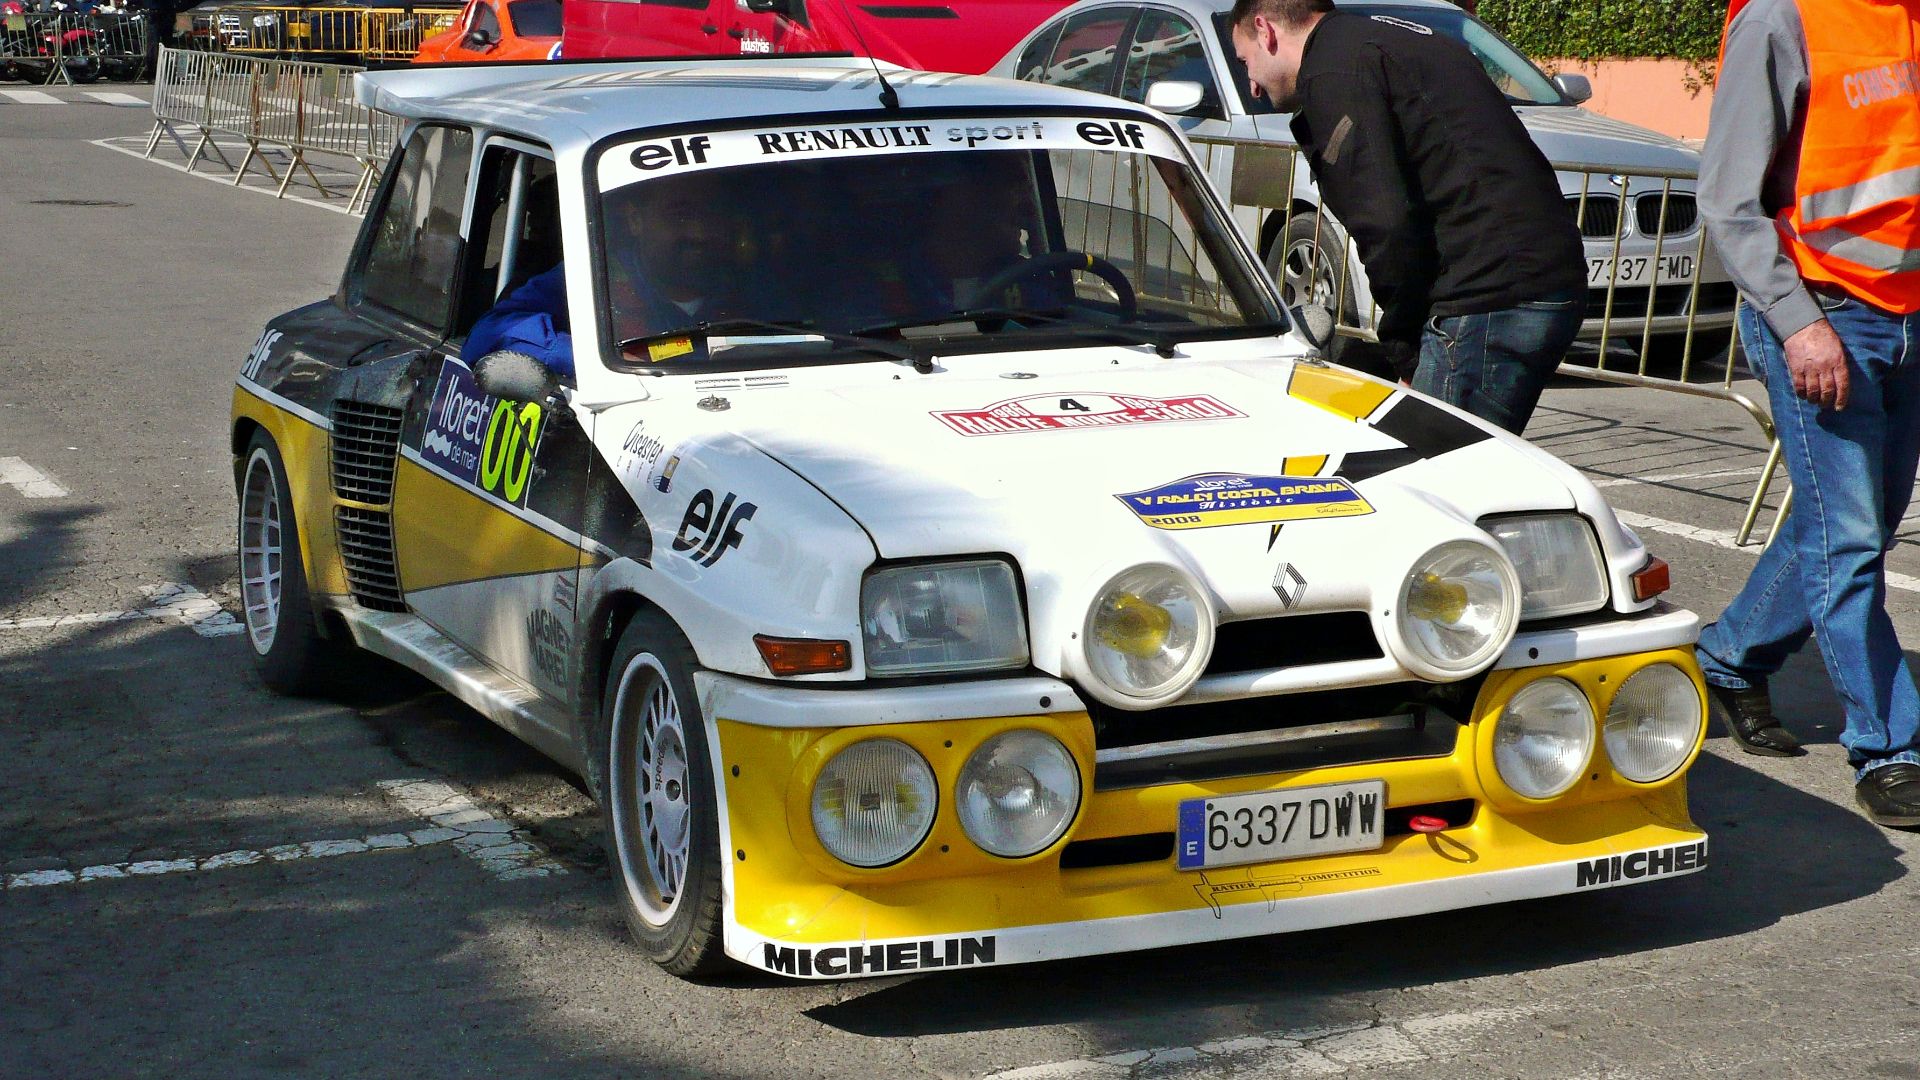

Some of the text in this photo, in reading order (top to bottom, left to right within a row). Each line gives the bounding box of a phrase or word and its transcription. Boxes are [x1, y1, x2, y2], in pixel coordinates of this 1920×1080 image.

[754, 122, 1044, 155] RENAULT sport
[1076, 121, 1145, 149] elf
[630, 136, 711, 170] elf
[1591, 255, 1693, 282] 7337 FMD
[438, 373, 490, 446] lloret
[947, 399, 1229, 434] RALLYE MONTE-CARLO
[987, 401, 1032, 418] 1986
[1059, 398, 1091, 412] 4
[450, 440, 477, 471] de mar
[481, 398, 541, 502] 00
[1134, 482, 1350, 505] V RALLY COSTA BRAVA
[1194, 478, 1251, 488] lloret
[671, 488, 758, 568] elf
[1151, 515, 1202, 525] 2008
[1208, 792, 1378, 851] 6337 DWW
[1186, 841, 1198, 856] E
[1211, 867, 1381, 893] RATIER COMPETITION
[1576, 842, 1708, 888] MICHEL
[764, 935, 996, 976] MICHELIN
